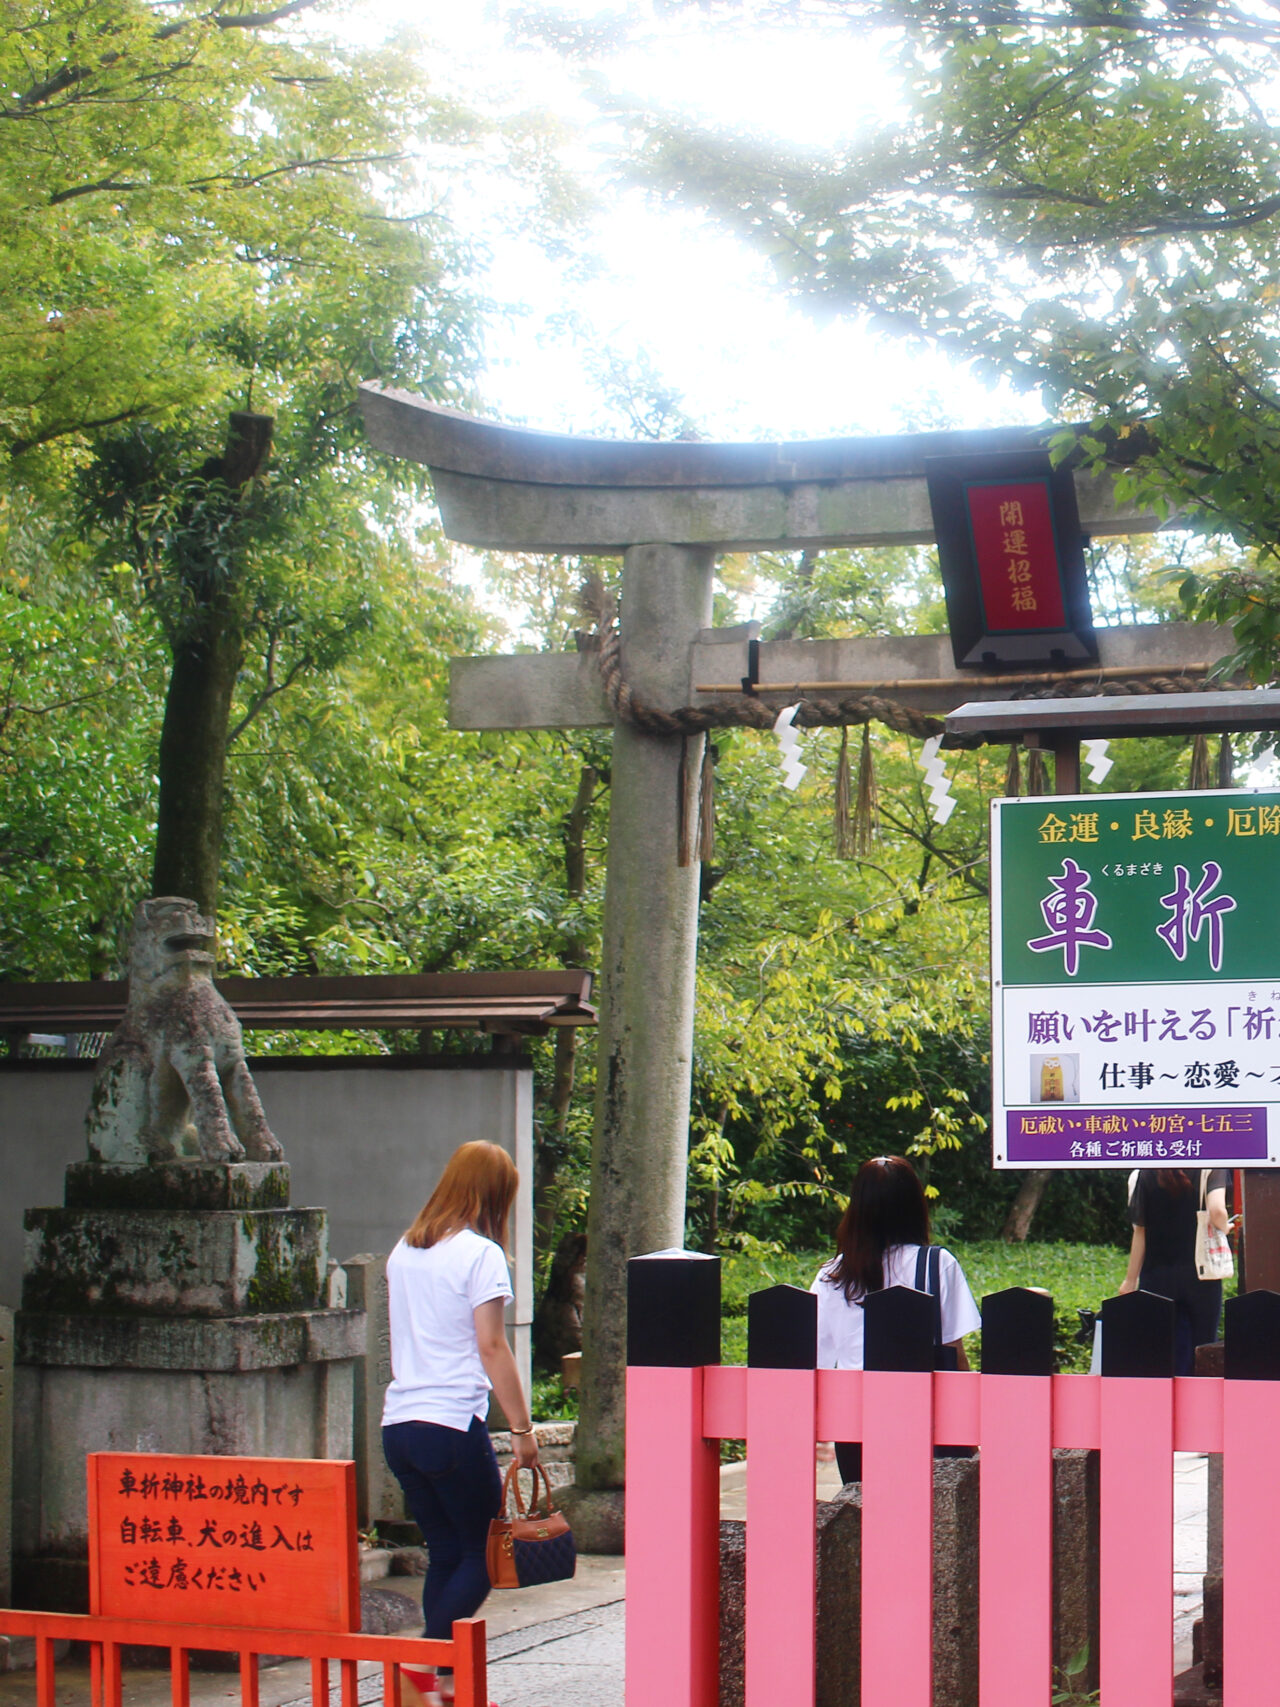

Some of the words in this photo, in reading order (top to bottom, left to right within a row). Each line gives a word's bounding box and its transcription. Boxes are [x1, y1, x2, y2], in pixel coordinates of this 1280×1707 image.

[999, 500, 1037, 611] 開運招福
[1099, 861, 1164, 877] くるまざき
[118, 1468, 304, 1506] 車折神社の境内です
[119, 1515, 314, 1552] 自転車、犬の進入は
[123, 1557, 267, 1592] ご遠慮ください
